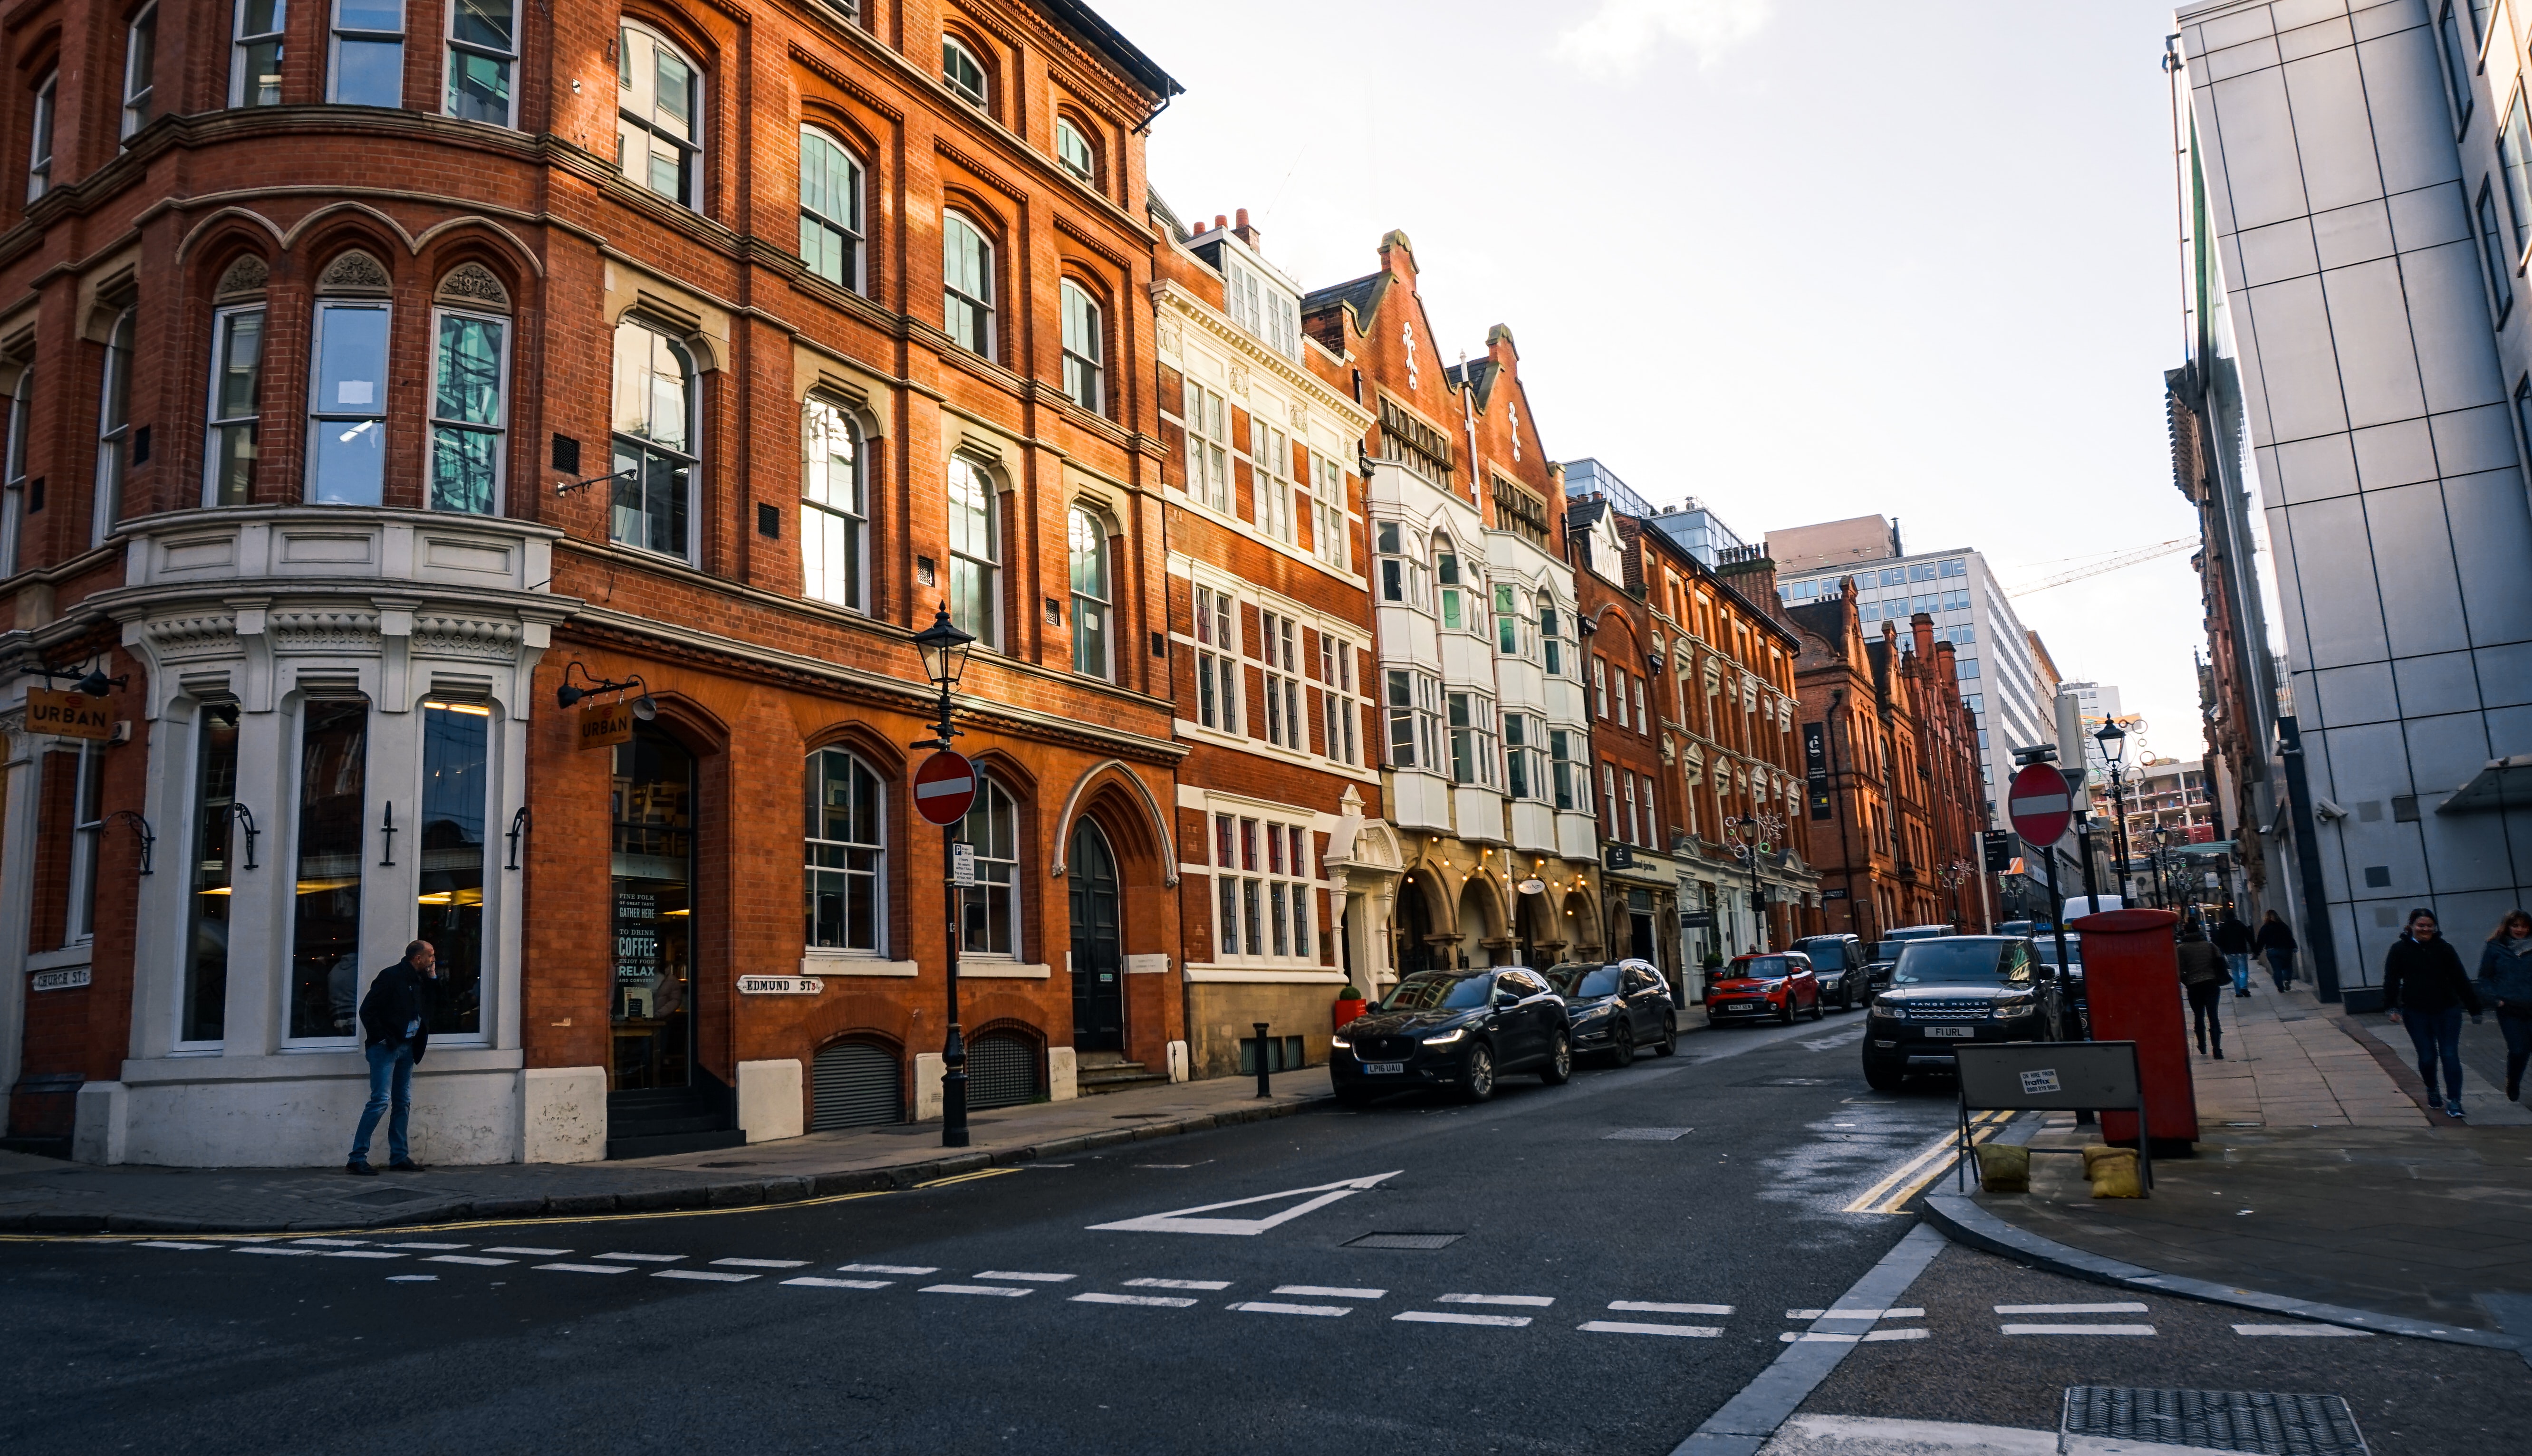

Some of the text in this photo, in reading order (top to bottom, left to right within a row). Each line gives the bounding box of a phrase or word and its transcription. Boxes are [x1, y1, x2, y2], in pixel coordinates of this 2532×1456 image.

[34, 705, 106, 728] URBAN
[583, 716, 627, 737] URBAN
[619, 907, 655, 919] GATHER HERE
[619, 937, 655, 956] COFFEE
[619, 966, 655, 976] RELAX
[39, 972, 67, 987] CHURCH
[72, 971, 82, 983] ST
[746, 981, 816, 991] EDMUND ST 3
[1946, 1028, 1963, 1036] URL
[1369, 1064, 1400, 1073] LP16 UAU
